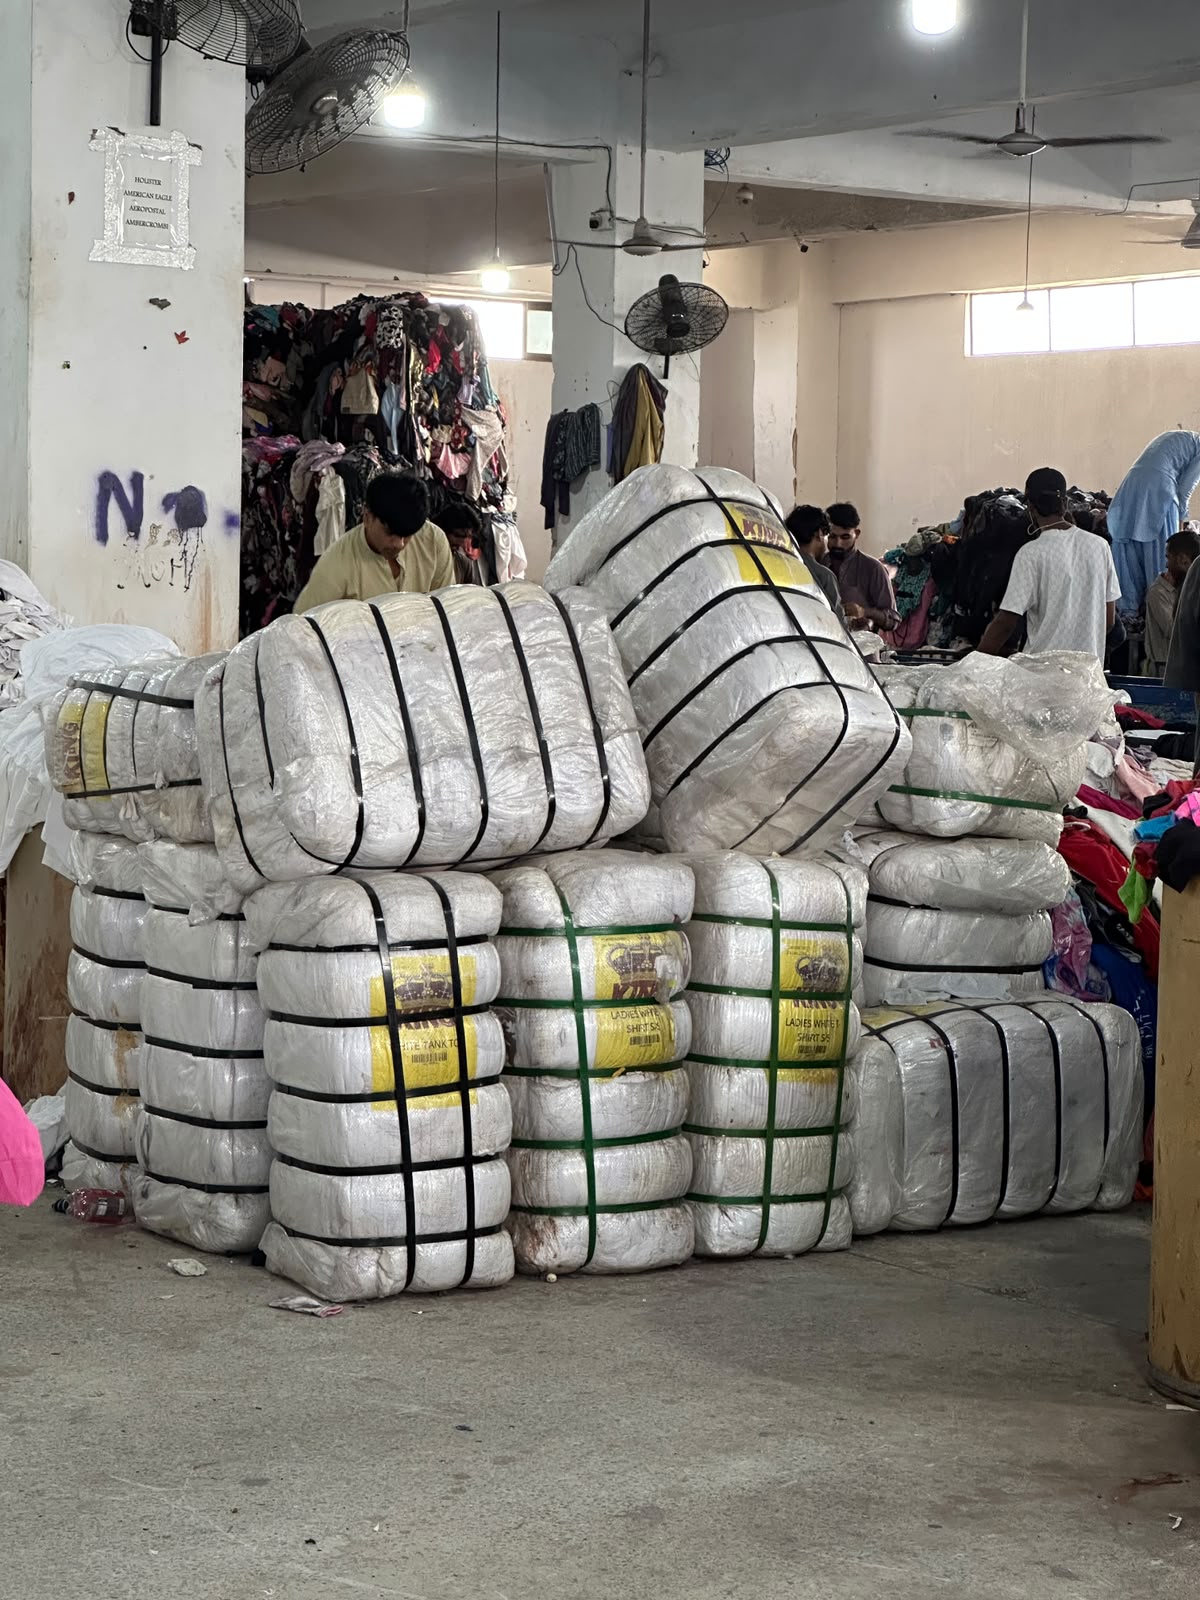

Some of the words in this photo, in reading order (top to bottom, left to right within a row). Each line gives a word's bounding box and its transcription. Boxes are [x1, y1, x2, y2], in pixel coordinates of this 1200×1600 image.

[123, 189, 154, 198] AMERICAN
[129, 205, 166, 214] AEROPOSTAL
[611, 1009, 639, 1020] LADIES
[785, 1017, 812, 1028] LADIES
[626, 1023, 649, 1034] SHIRT
[797, 1032, 820, 1042] SHIRT
[423, 1040, 448, 1050] TANK
